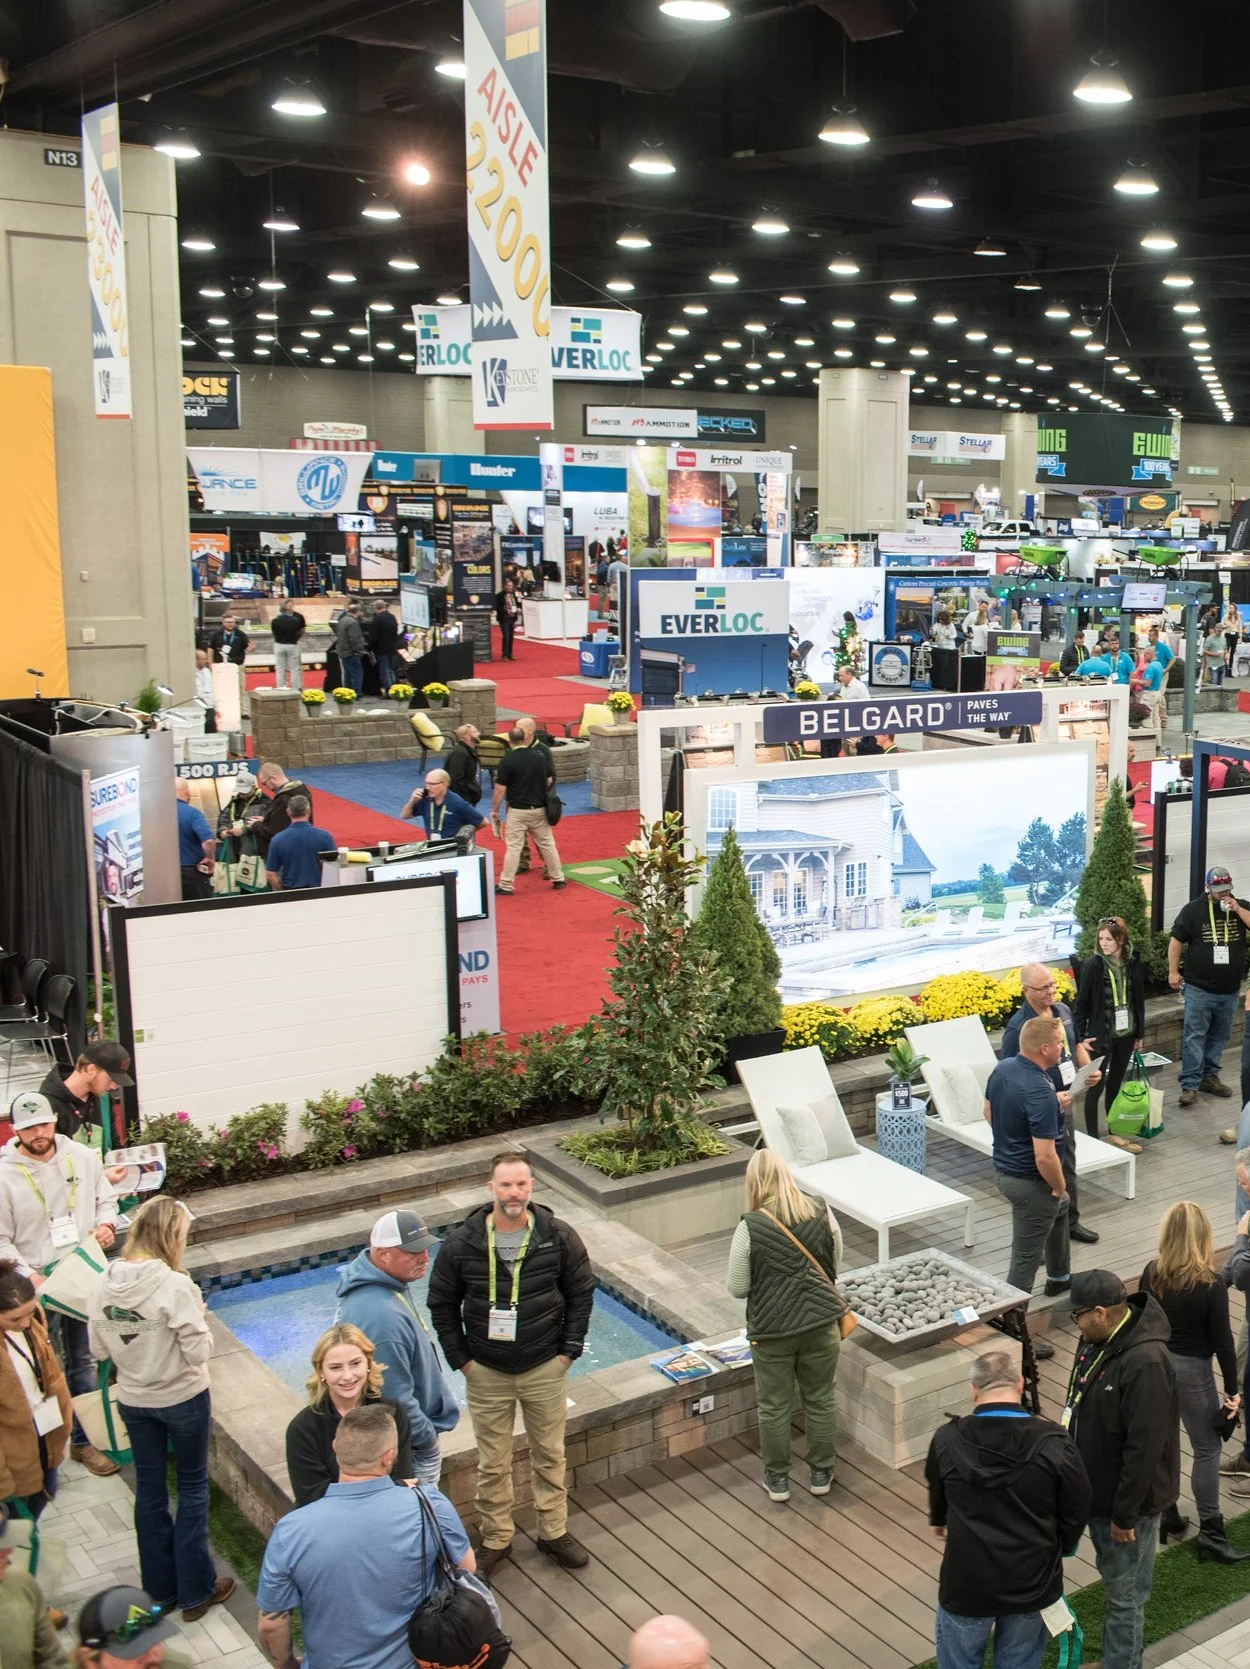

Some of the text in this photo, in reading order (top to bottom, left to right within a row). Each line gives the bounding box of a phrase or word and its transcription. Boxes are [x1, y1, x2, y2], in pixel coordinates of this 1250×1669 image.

[477, 67, 538, 187] AISLE
[47, 151, 78, 167] N13
[91, 175, 120, 256] AISLE
[418, 343, 472, 366] ERLOC
[551, 346, 632, 373] VERLOC
[697, 416, 758, 434] ECKED
[710, 455, 743, 465] Irritrol
[470, 463, 517, 477] Hunter
[661, 613, 765, 635] EVERLOC
[967, 699, 998, 710] PAVES
[967, 712, 986, 723] THE
[218, 762, 249, 776] RJS
[91, 778, 137, 808] SUREBOND
[462, 974, 489, 986] PAYS
